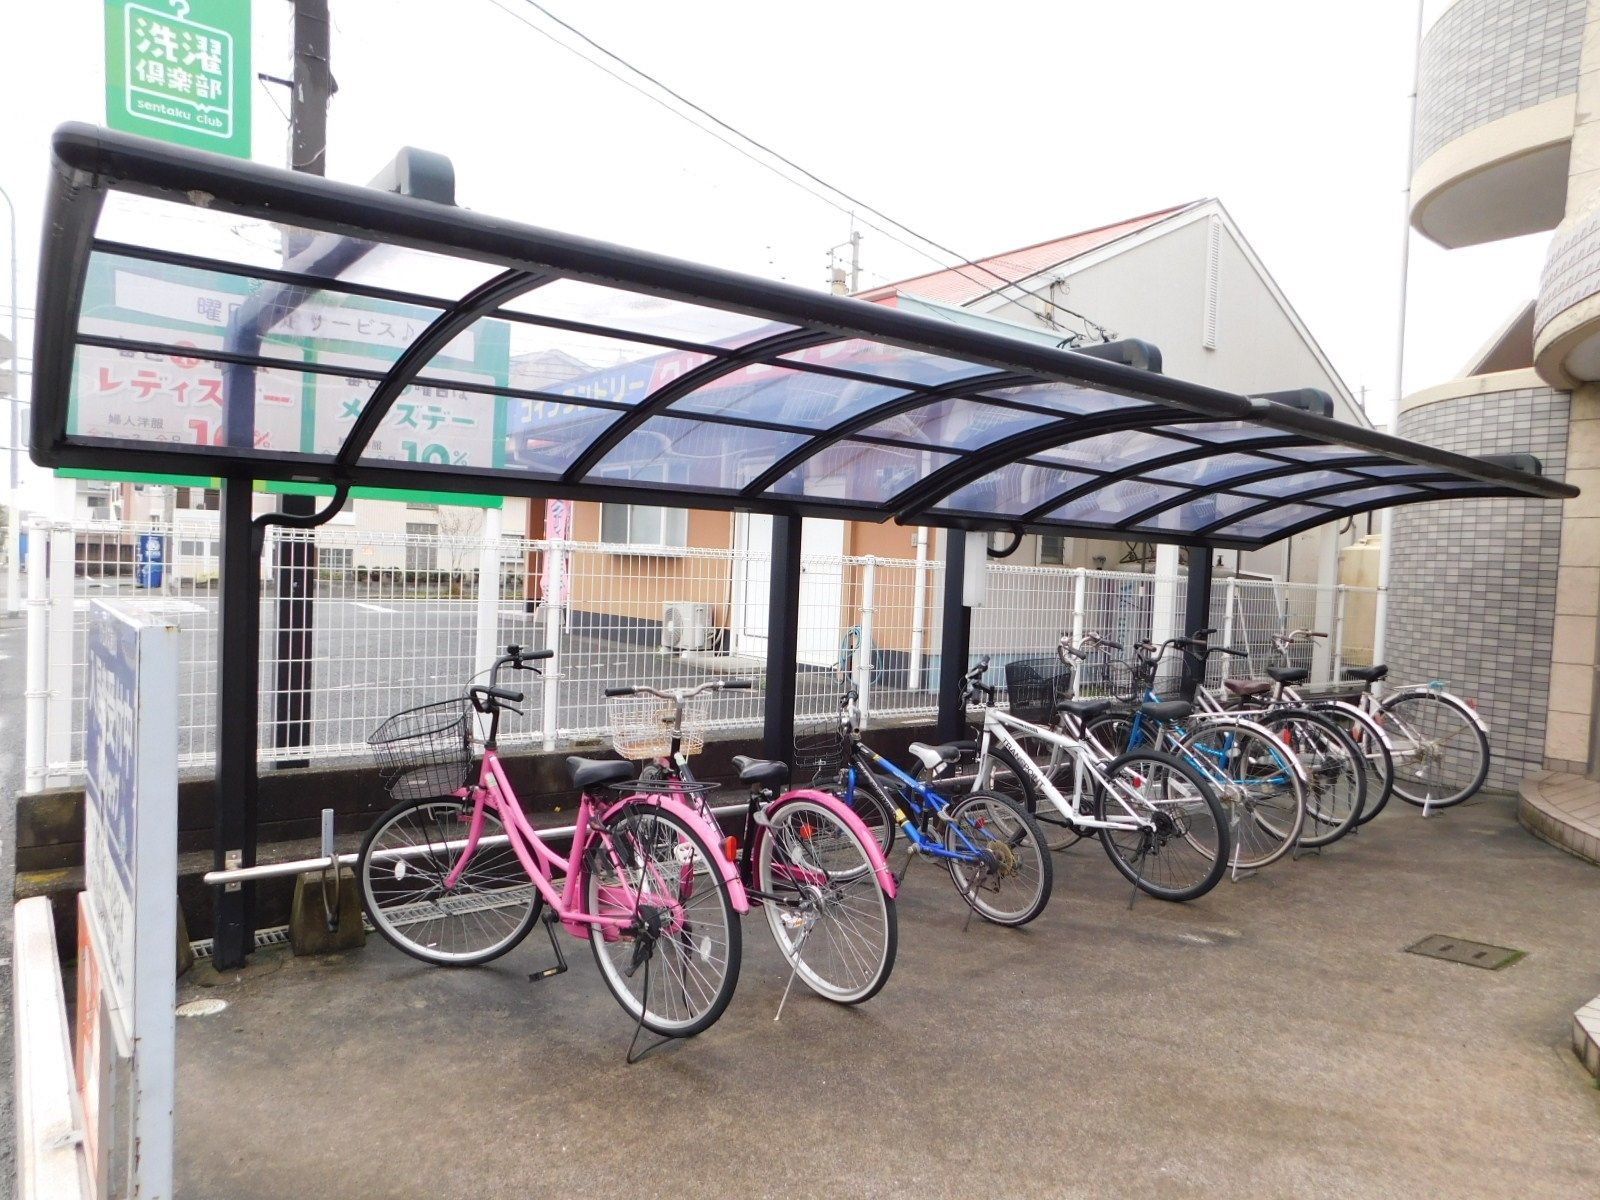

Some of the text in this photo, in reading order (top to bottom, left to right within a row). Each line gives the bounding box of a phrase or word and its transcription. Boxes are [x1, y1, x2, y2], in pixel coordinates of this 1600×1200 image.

[136, 17, 222, 76] 洗濯
[136, 58, 222, 100] 倶楽部
[137, 99, 223, 128] sentaku club
[338, 397, 475, 430] メズデー
